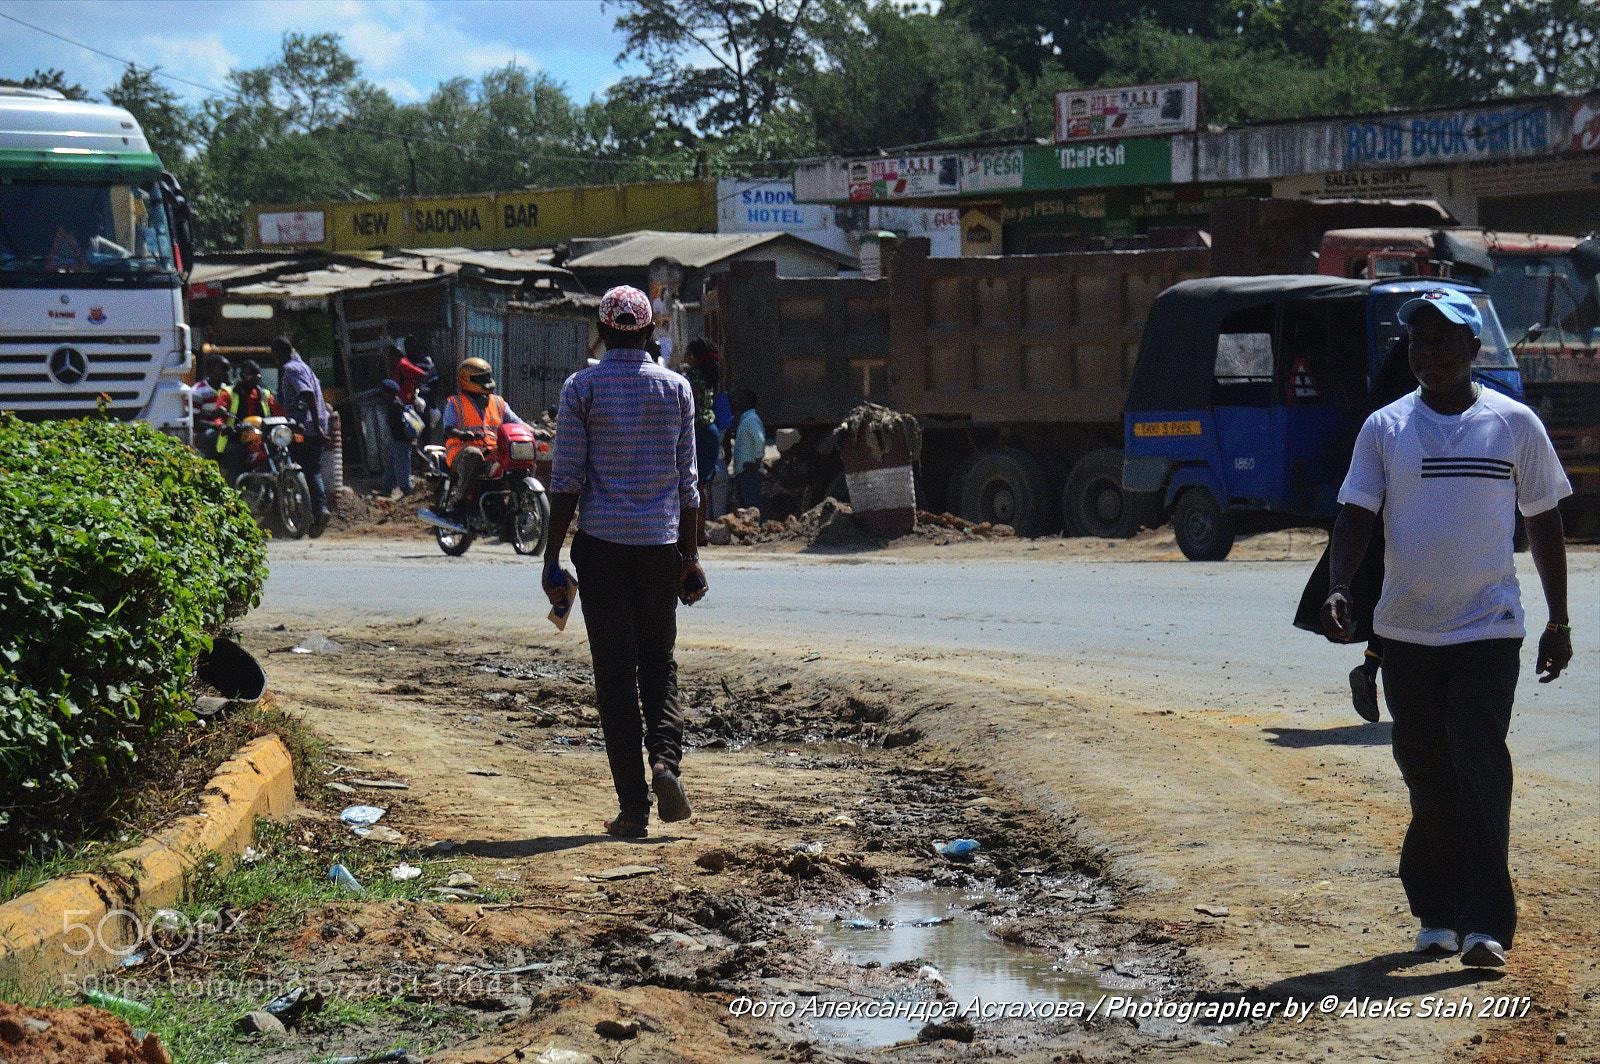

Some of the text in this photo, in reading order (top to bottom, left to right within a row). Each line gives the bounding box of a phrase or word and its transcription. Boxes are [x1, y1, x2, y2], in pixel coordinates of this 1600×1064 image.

[1412, 114, 1467, 157] BOOK
[1473, 108, 1548, 152] CENTRE
[983, 155, 1022, 177] PESA
[1324, 171, 1358, 186] SALES
[1372, 168, 1411, 183] SUPPLY
[353, 203, 539, 236] NEW SADONA BAR
[748, 209, 804, 224] HOTEL
